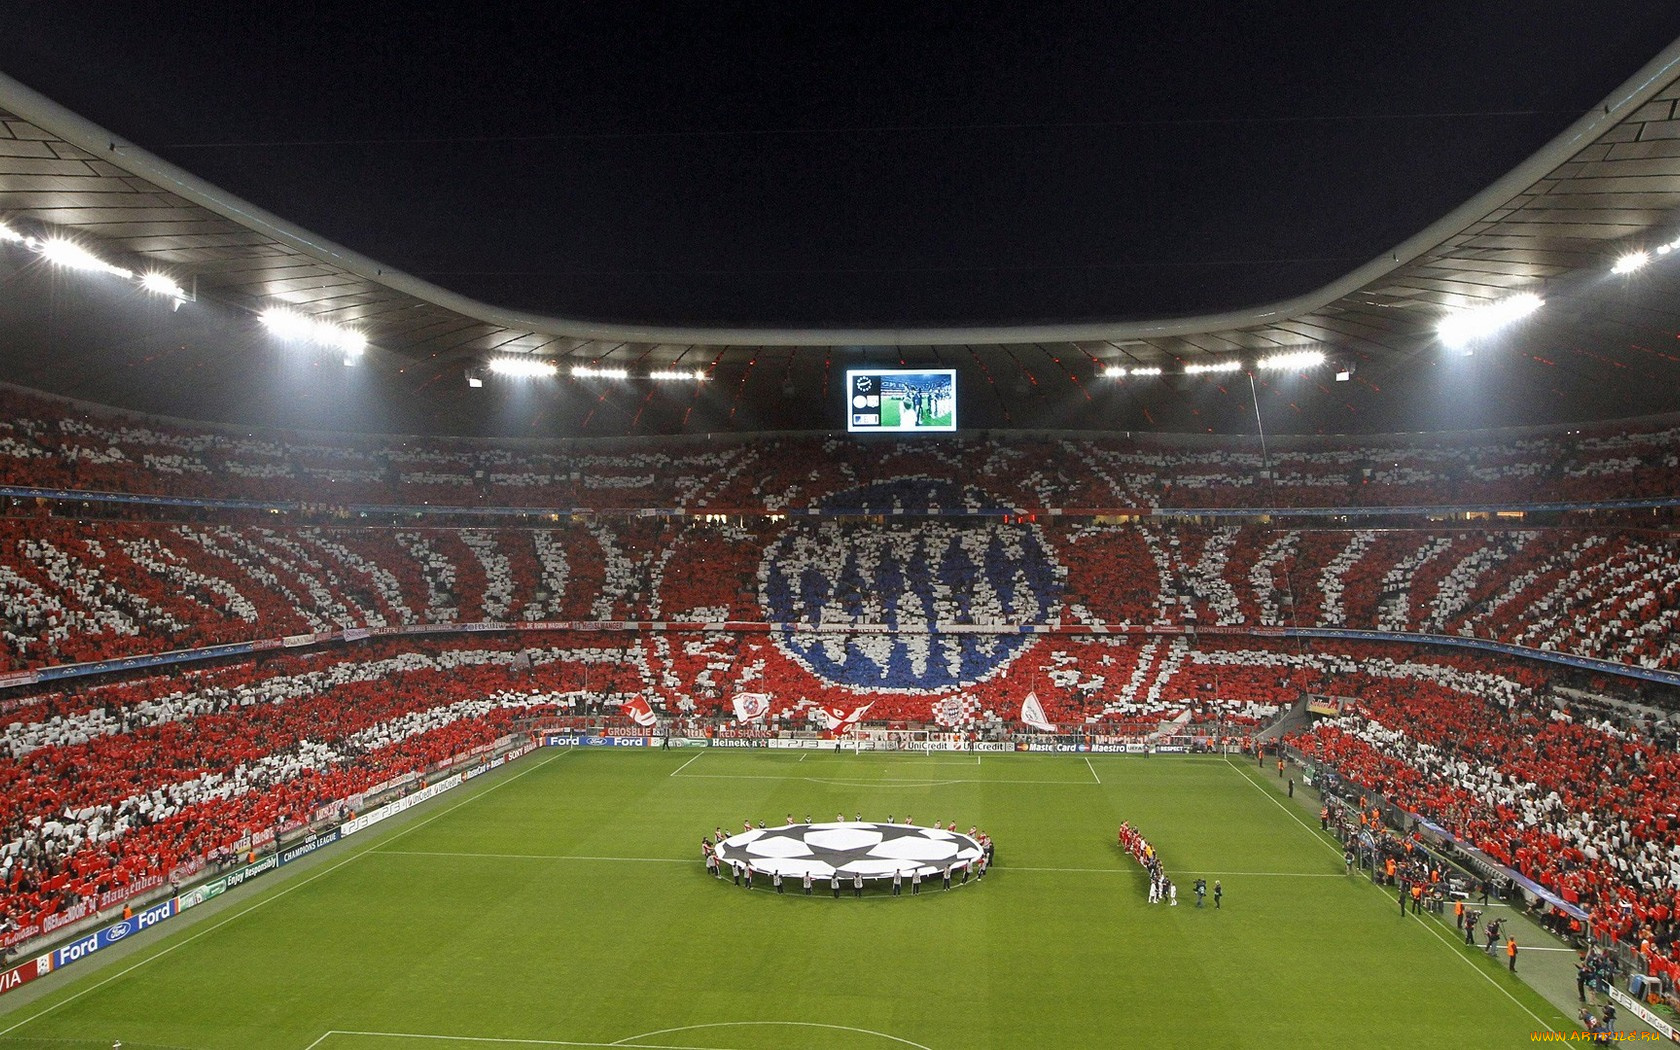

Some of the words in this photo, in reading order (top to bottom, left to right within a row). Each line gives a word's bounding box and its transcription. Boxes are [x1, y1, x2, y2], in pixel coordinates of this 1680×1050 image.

[720, 730, 736, 738] RED
[738, 730, 772, 738] SHARKS
[550, 736, 580, 746] Ford
[613, 737, 643, 747] Ford
[907, 741, 948, 750] UniCredit
[963, 742, 1003, 751] UiCredit
[1029, 743, 1077, 752] MasteCard
[508, 748, 524, 761] SONY
[1091, 744, 1126, 752] Maestro
[413, 788, 432, 805] UniCredit
[381, 802, 400, 817] PS3
[349, 815, 369, 833] PS3
[283, 842, 317, 863] CHAMPIONS
[316, 832, 337, 848] LEAGUE
[227, 871, 245, 886] Enjoy
[244, 856, 277, 878] Responsibly
[138, 901, 171, 930] Ford
[60, 934, 98, 966] Ford
